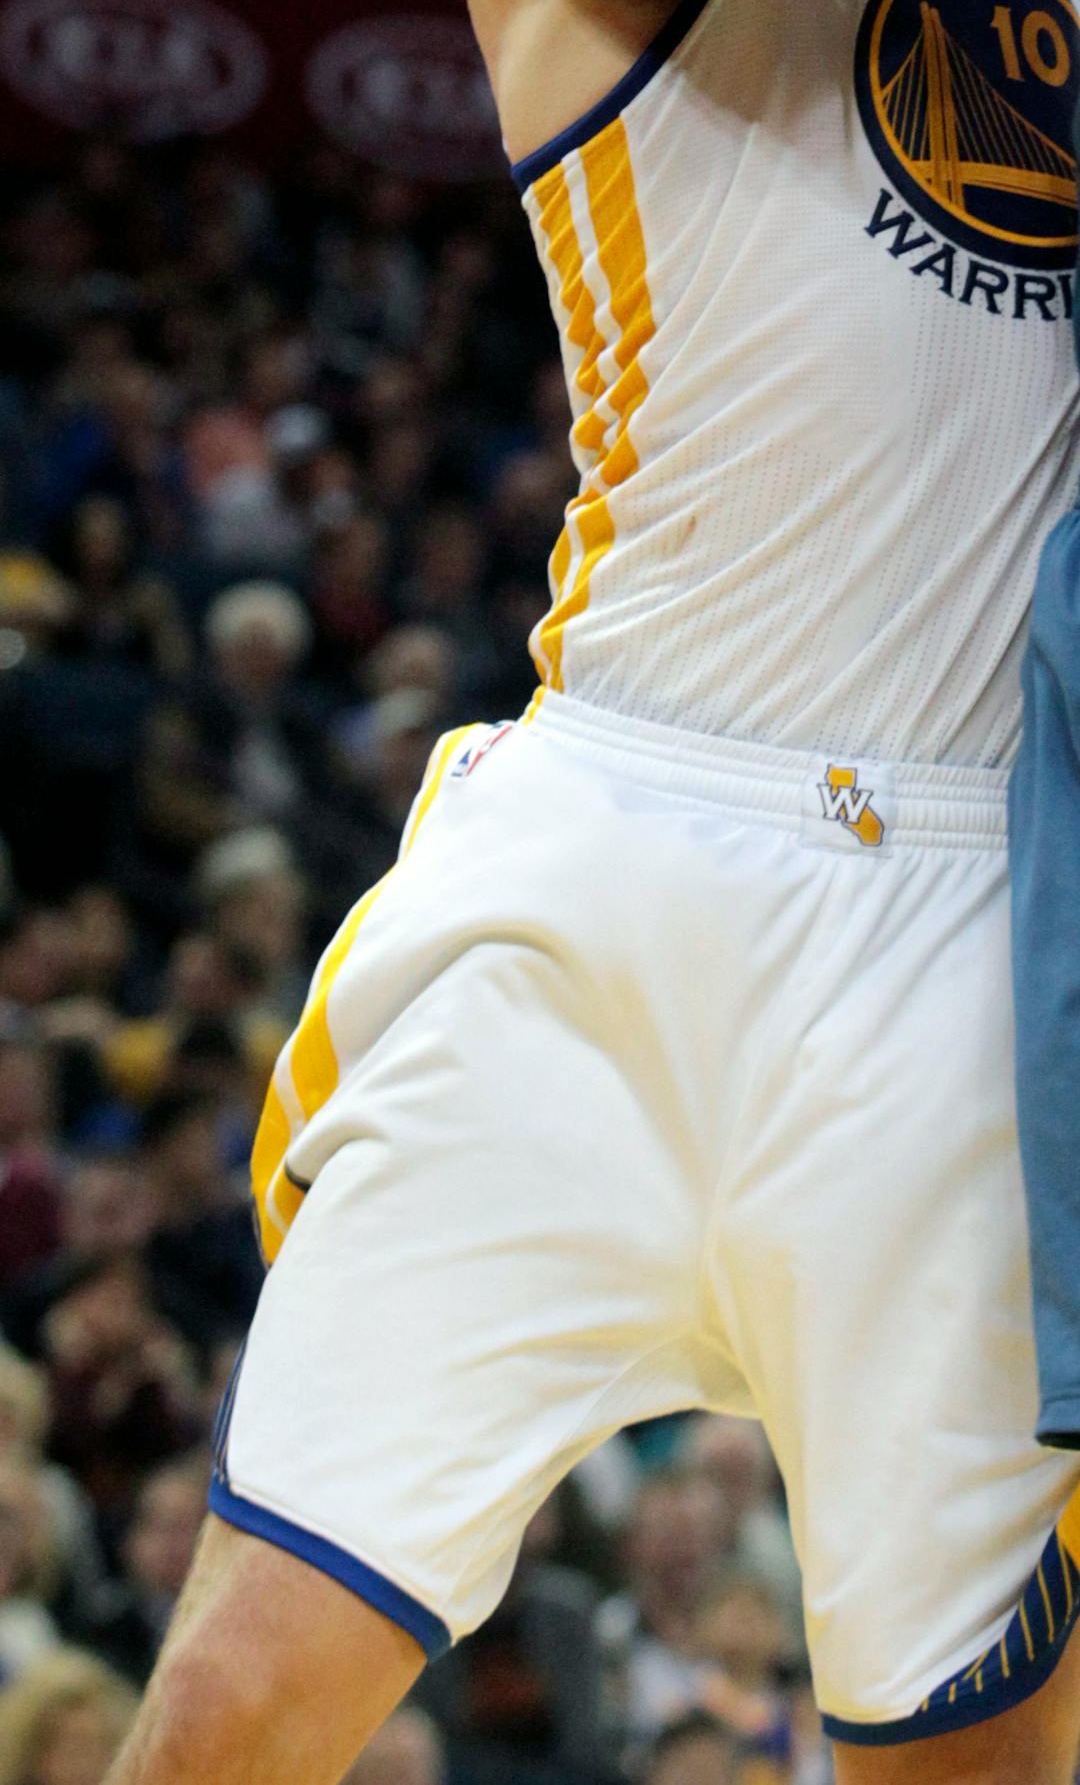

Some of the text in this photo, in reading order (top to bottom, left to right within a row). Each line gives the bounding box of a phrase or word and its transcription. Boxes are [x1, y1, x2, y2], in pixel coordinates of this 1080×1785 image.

[990, 5, 1071, 88] 10
[864, 187, 1075, 321] WARRI
[816, 782, 875, 824] W
